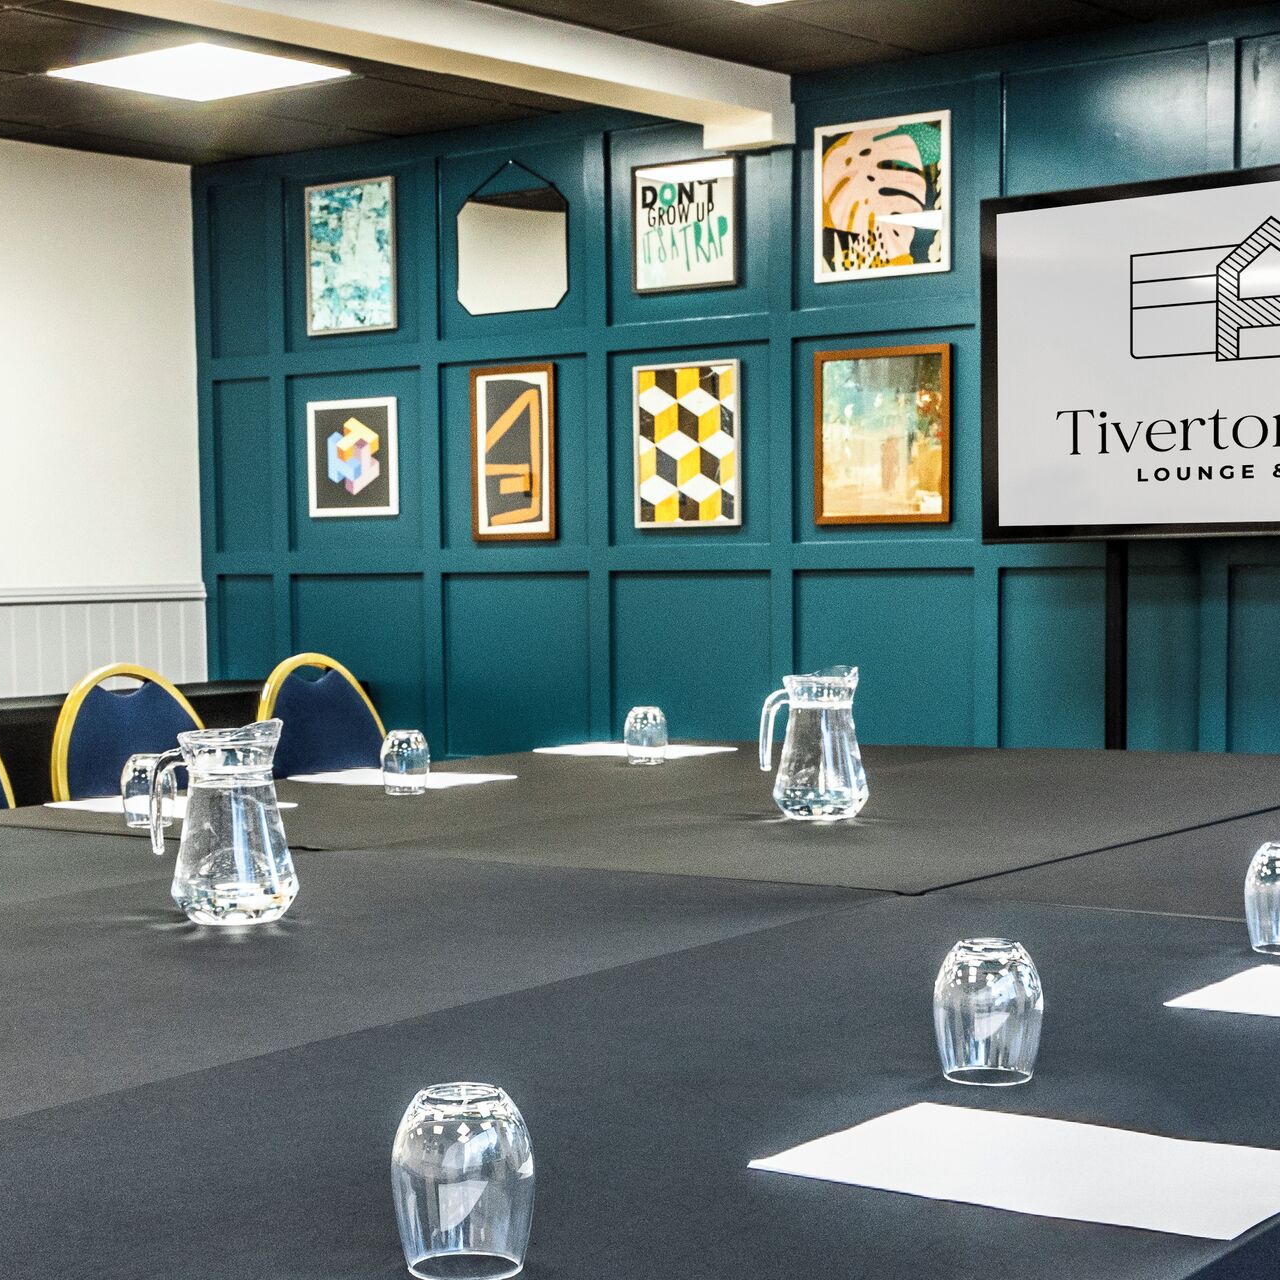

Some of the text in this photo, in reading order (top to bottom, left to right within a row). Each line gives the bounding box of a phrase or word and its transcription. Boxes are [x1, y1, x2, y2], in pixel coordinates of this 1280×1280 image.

[648, 201, 715, 228] GROW UP
[670, 226, 679, 261] A
[678, 214, 728, 272] TRAP
[1137, 464, 1256, 482] LOUNGE
